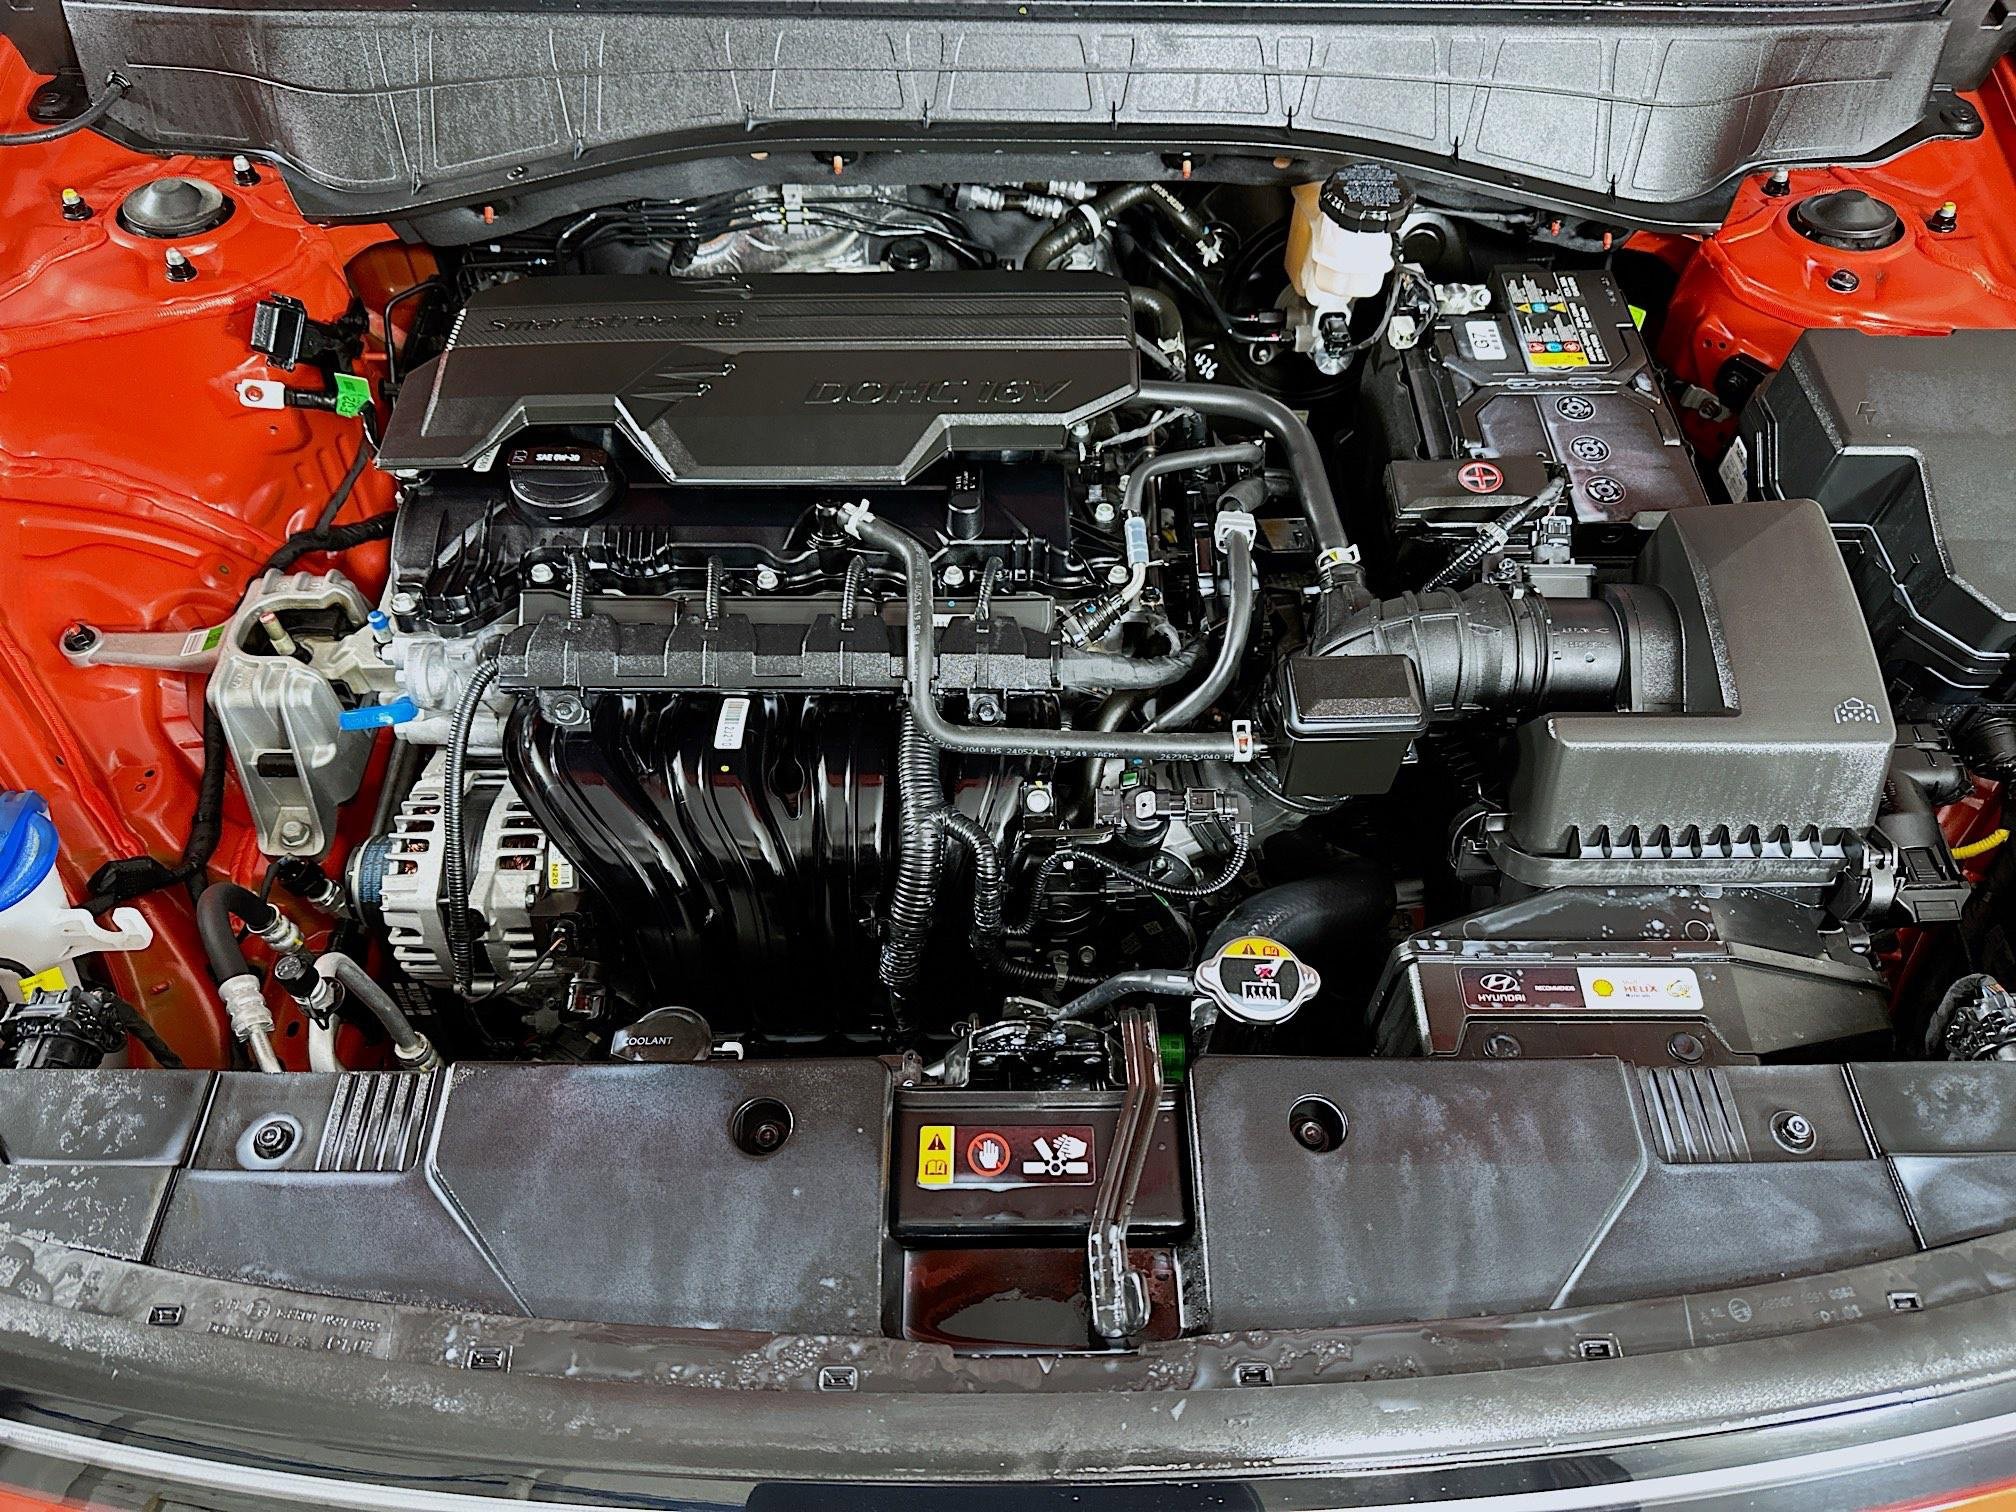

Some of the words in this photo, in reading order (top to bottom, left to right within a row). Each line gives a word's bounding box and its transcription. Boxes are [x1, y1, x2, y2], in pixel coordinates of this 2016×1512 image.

[804, 378, 969, 405] DOHC
[978, 378, 1073, 404] 16V
[535, 453, 553, 461] SAE
[553, 453, 580, 461] 0W-20
[1623, 985, 1658, 993] HELIX
[1477, 994, 1527, 1002] HYUNDAI
